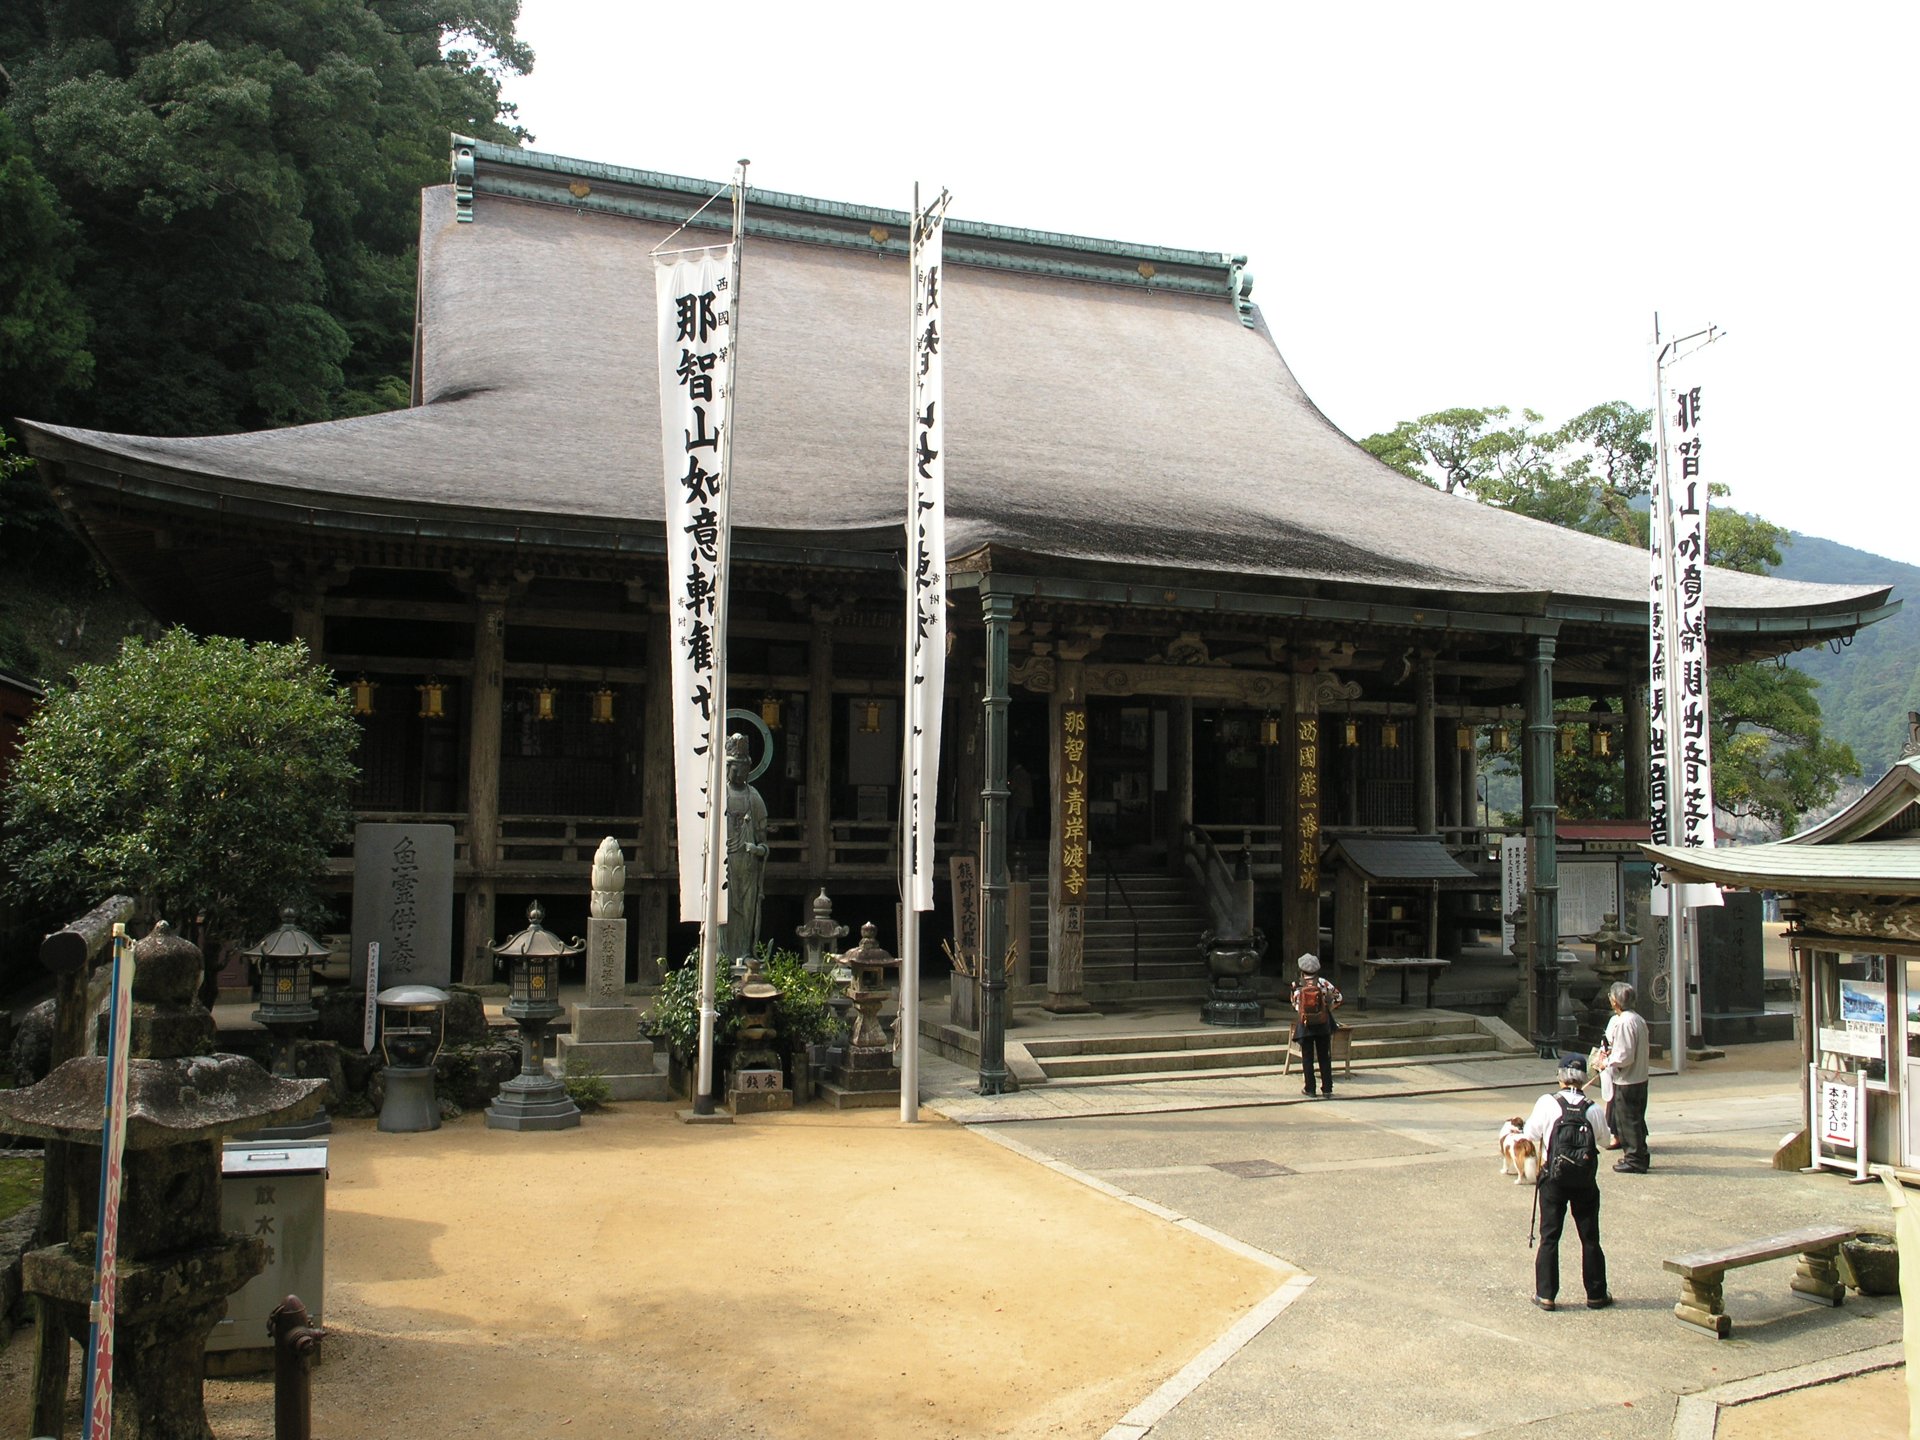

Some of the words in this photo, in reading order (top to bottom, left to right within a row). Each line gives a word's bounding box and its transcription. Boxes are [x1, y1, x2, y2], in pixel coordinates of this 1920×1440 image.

[1063, 711, 1085, 895] 那智山青岸渡寺
[1299, 720, 1318, 893] 西國第一番札所
[956, 862, 977, 968] 熊野曼陀羅
[1828, 1087, 1839, 1132] 本堂入口
